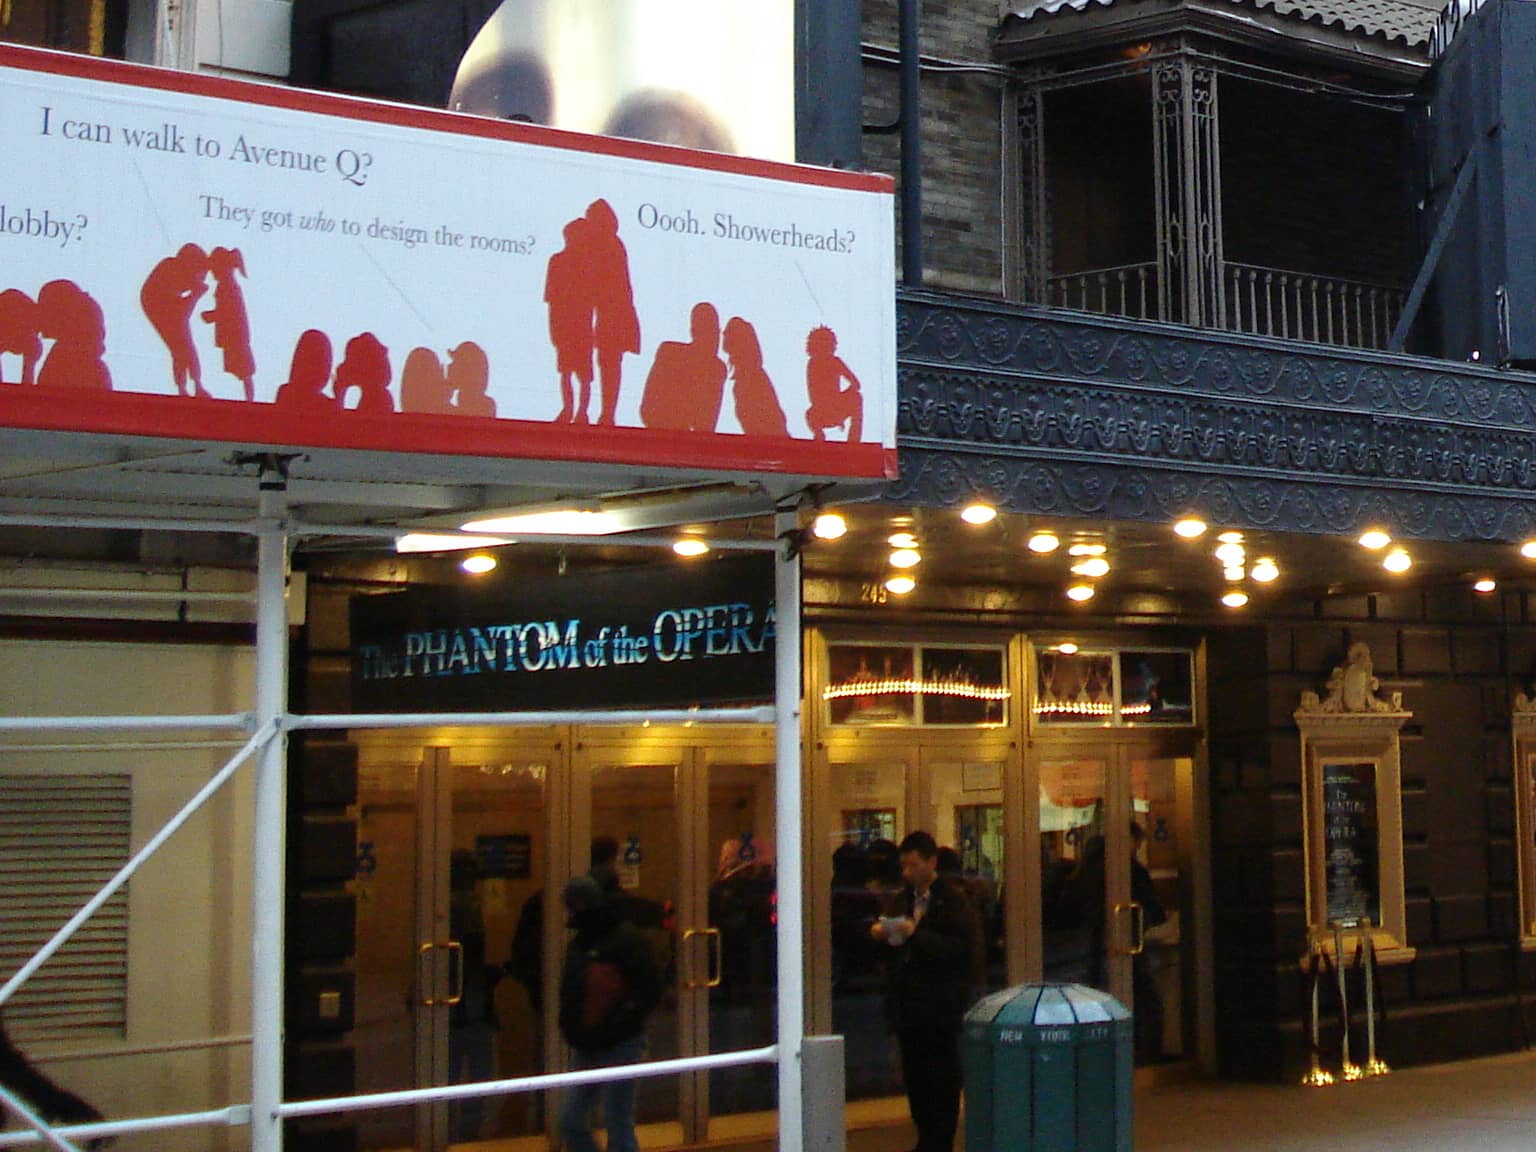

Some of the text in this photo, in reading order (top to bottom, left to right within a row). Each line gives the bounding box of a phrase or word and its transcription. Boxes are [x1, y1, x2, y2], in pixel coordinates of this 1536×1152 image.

[39, 107, 375, 187] I can walk to Avenue Q?
[0, 205, 89, 248] lobby?
[199, 195, 536, 255] They got who to design the rooms?
[637, 202, 857, 254] Oooh. Showerheads?
[360, 646, 399, 680] The
[403, 619, 581, 677] PHANTOM
[584, 627, 611, 668] of
[612, 626, 648, 665] the
